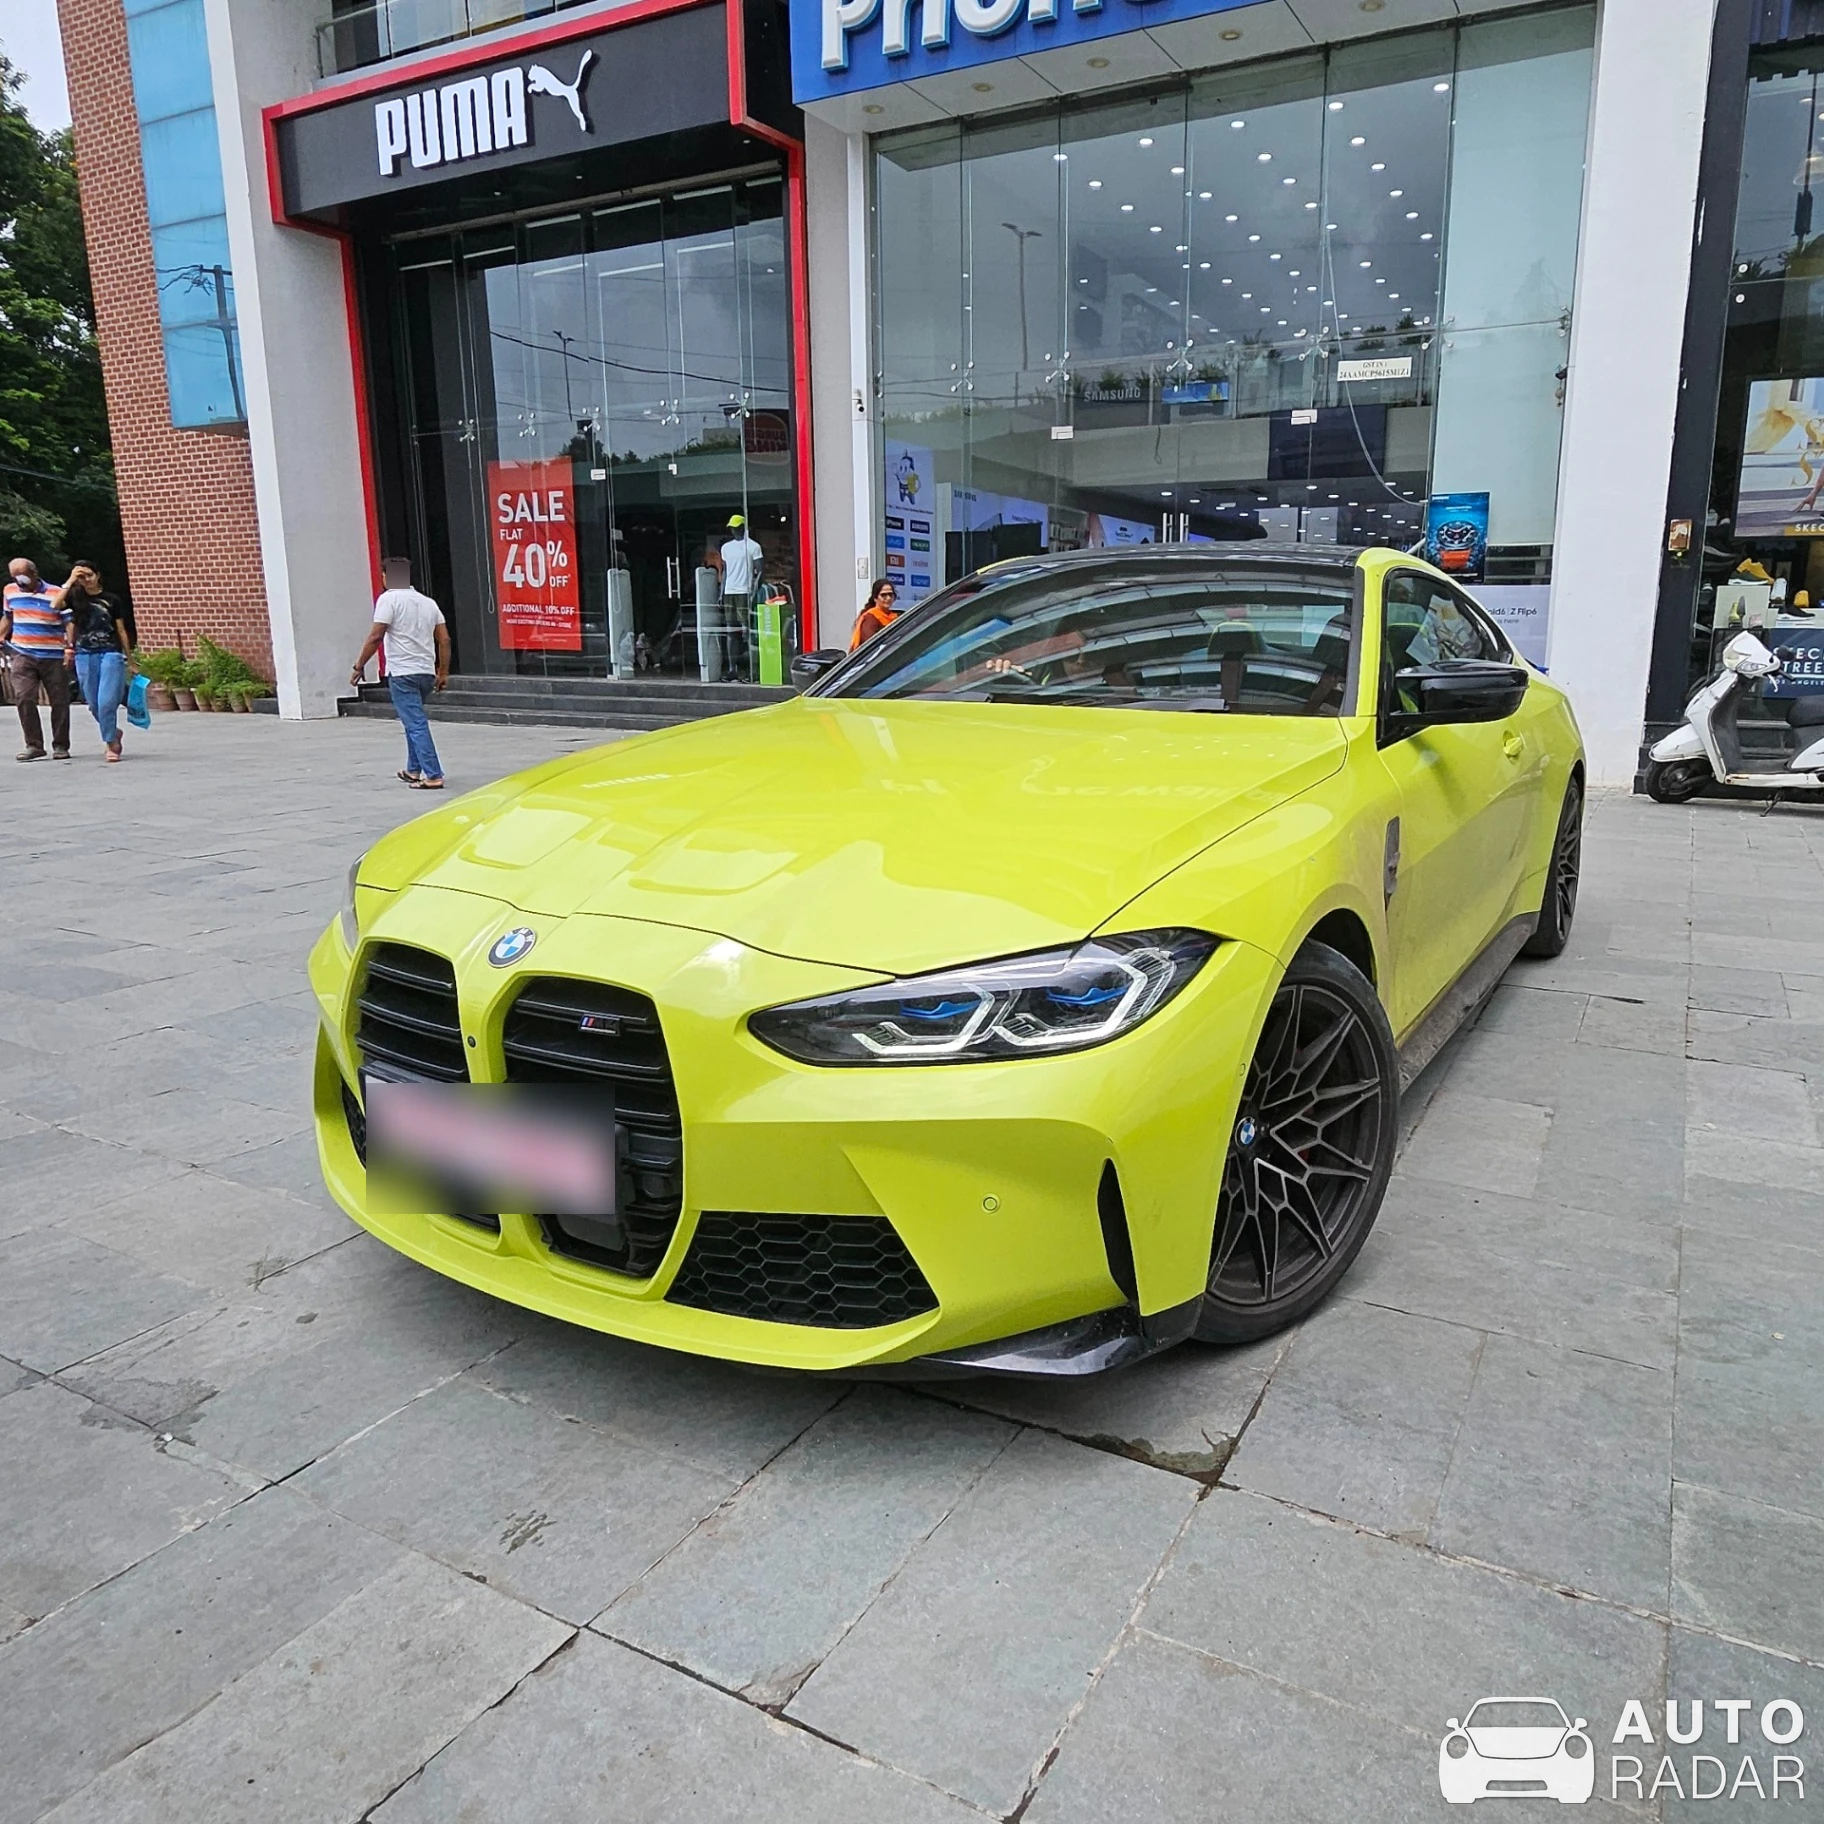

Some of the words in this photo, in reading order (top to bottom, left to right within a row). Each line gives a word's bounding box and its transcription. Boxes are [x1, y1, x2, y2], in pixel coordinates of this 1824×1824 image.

[374, 66, 529, 176] PUMA
[1083, 387, 1141, 402] SAMSUNG
[497, 490, 566, 524] SALE
[500, 528, 523, 540] FLAT
[502, 540, 568, 588] 40%
[502, 603, 544, 613] ADDITIONAL
[560, 606, 576, 616] OFF
[1510, 607, 1516, 615] Z
[1517, 607, 1537, 617] Flip6
